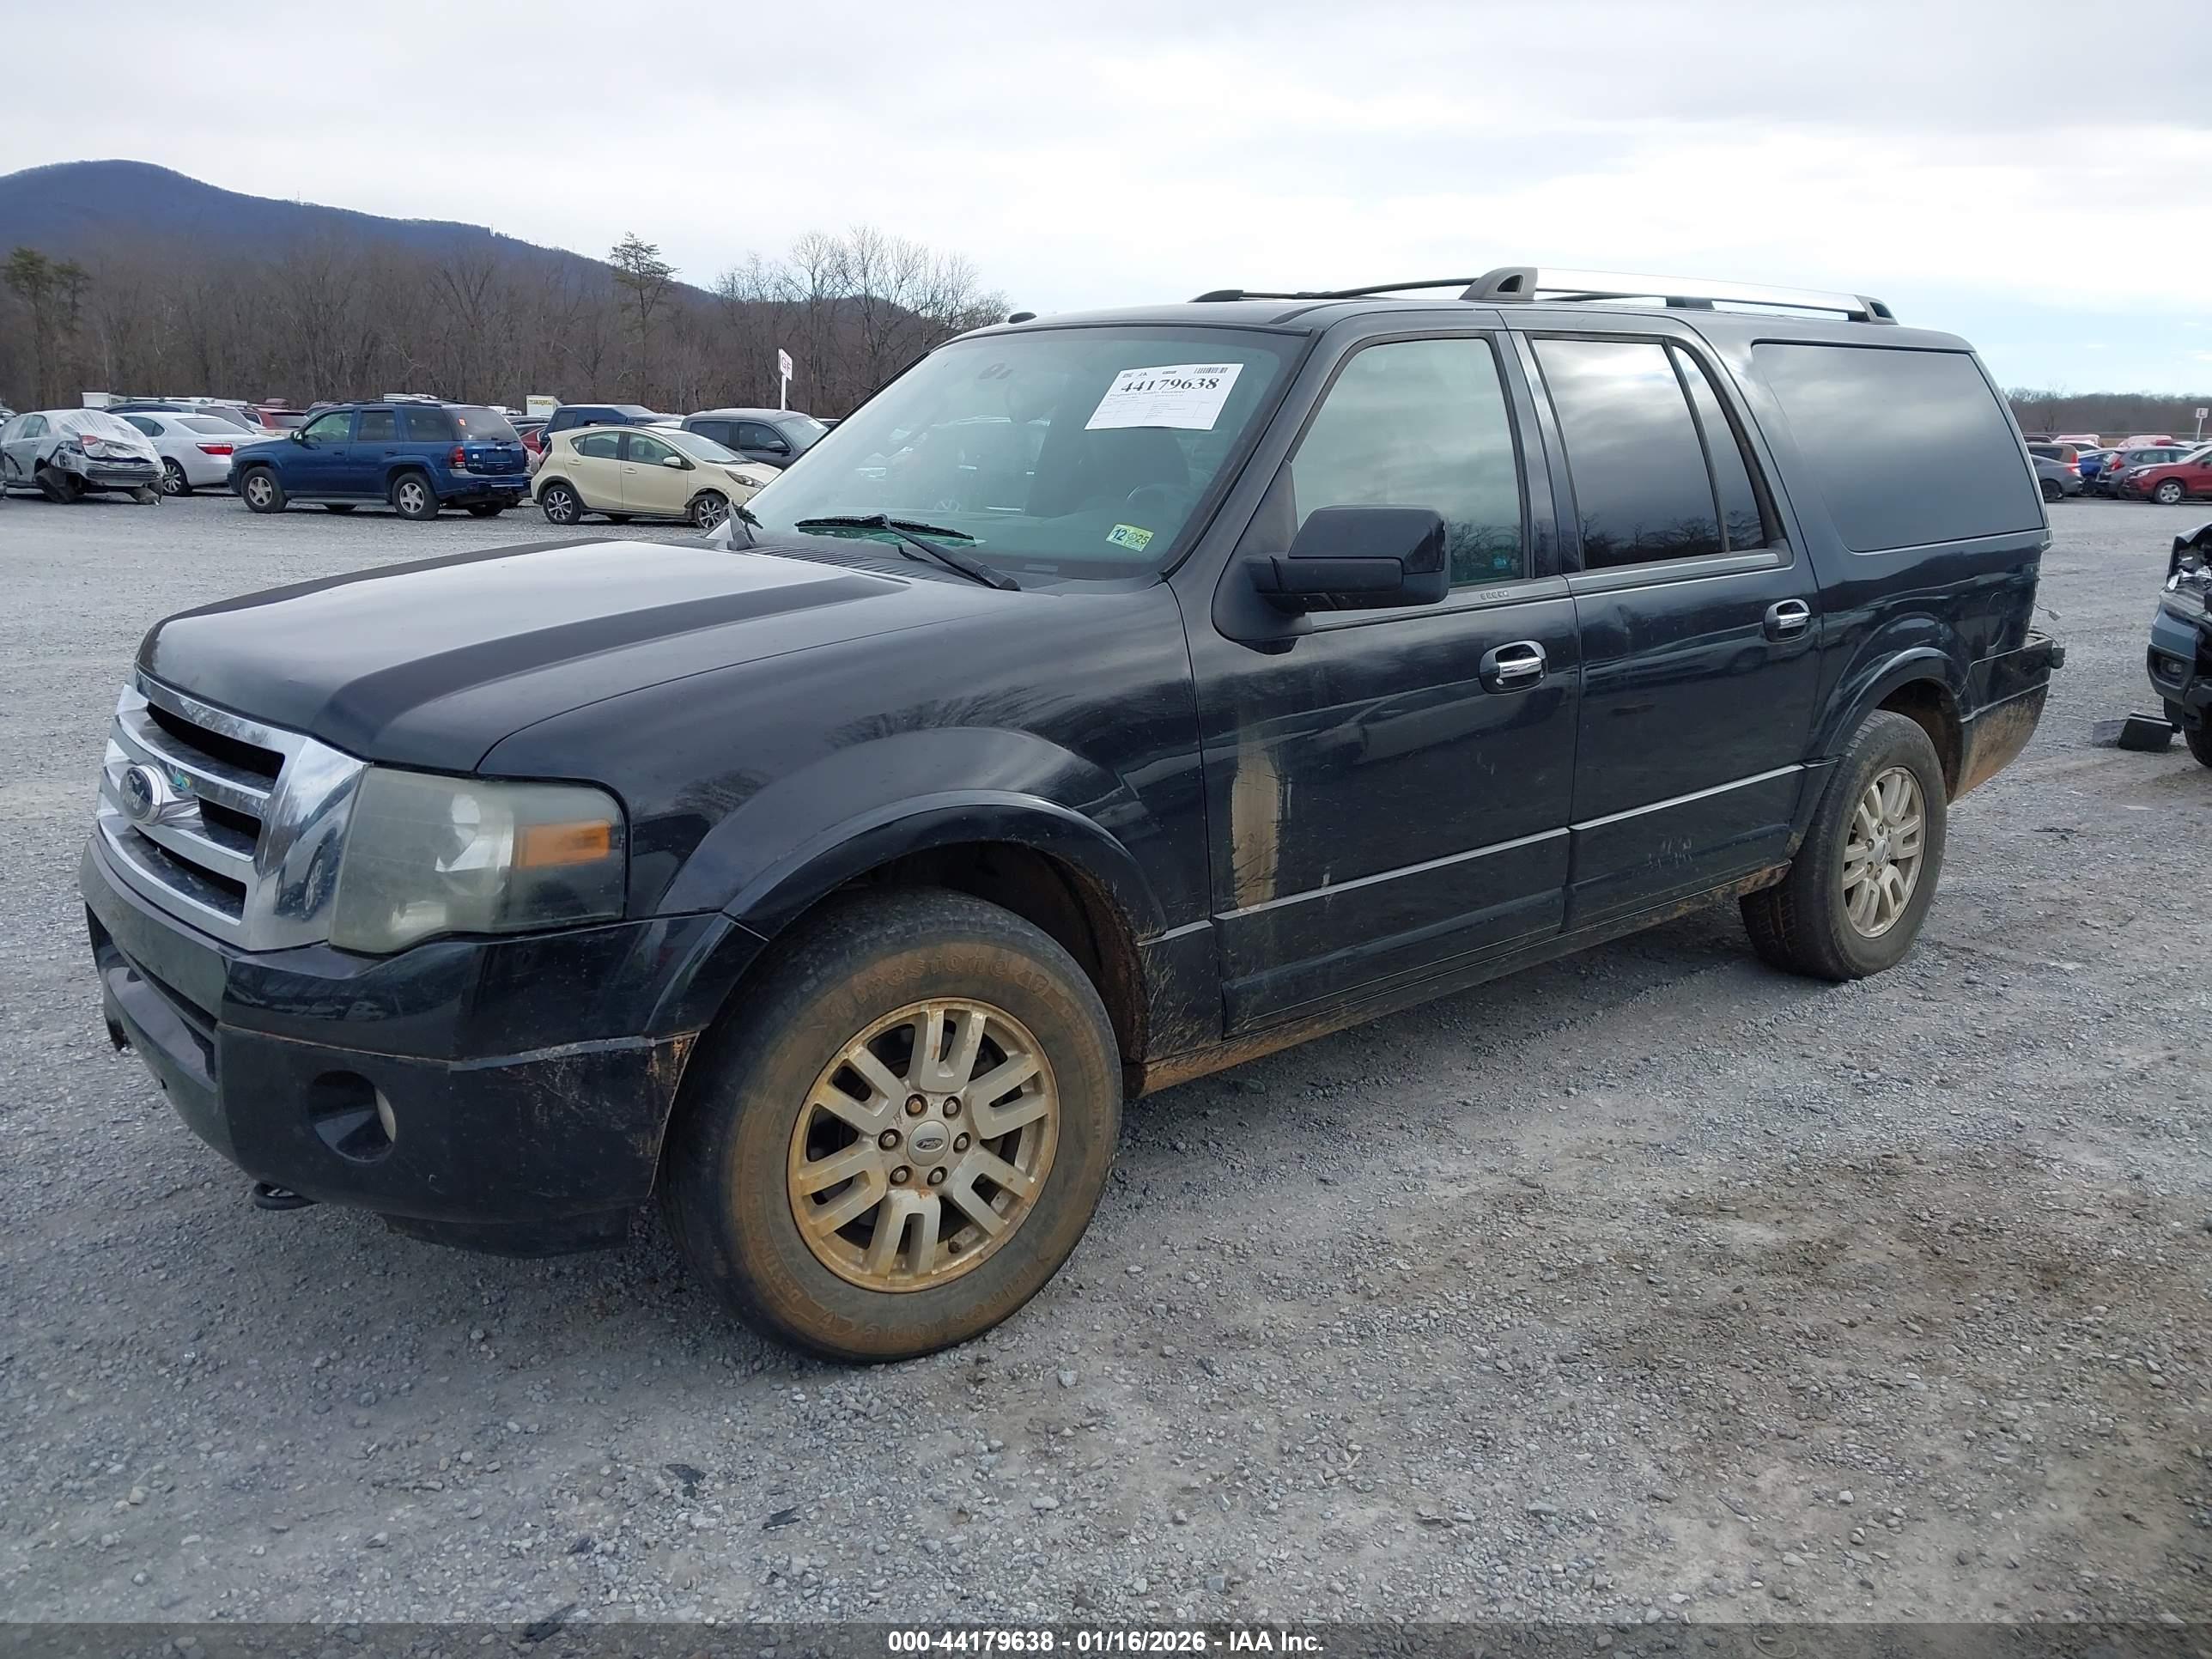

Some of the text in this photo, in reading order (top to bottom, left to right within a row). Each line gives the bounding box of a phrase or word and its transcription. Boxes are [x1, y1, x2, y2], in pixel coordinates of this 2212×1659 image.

[1121, 377, 1220, 392] 44179638
[1112, 528, 1127, 541] 12
[1134, 534, 1150, 545] 25
